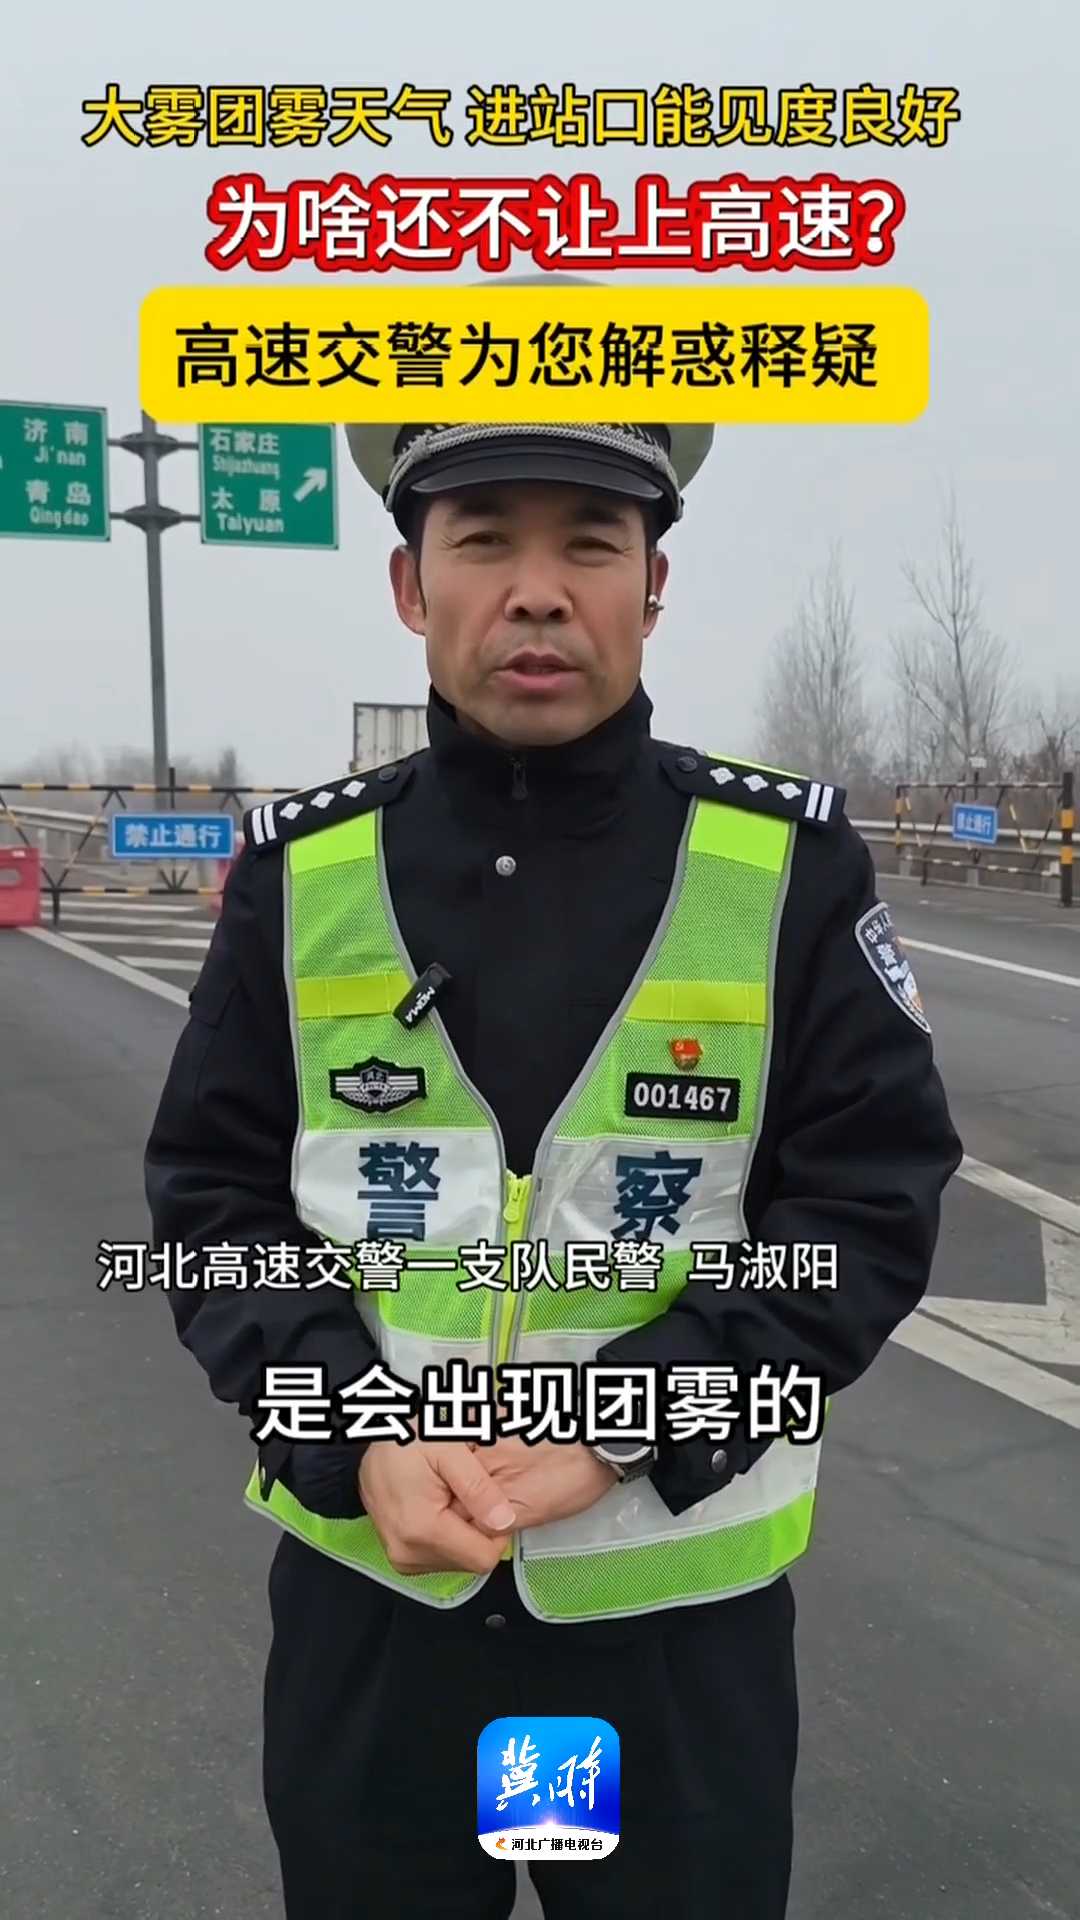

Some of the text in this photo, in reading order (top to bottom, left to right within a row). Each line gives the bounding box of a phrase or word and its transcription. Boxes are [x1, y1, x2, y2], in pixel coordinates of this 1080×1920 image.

[23, 417, 89, 446] 济南
[208, 426, 281, 456] 石家庄
[25, 479, 91, 506] 青岛
[210, 486, 282, 513] 太原
[216, 512, 285, 535] Taiyuan
[124, 823, 222, 849] 禁止通行
[632, 1081, 732, 1113] 001467
[357, 1140, 704, 1242] 警 察
